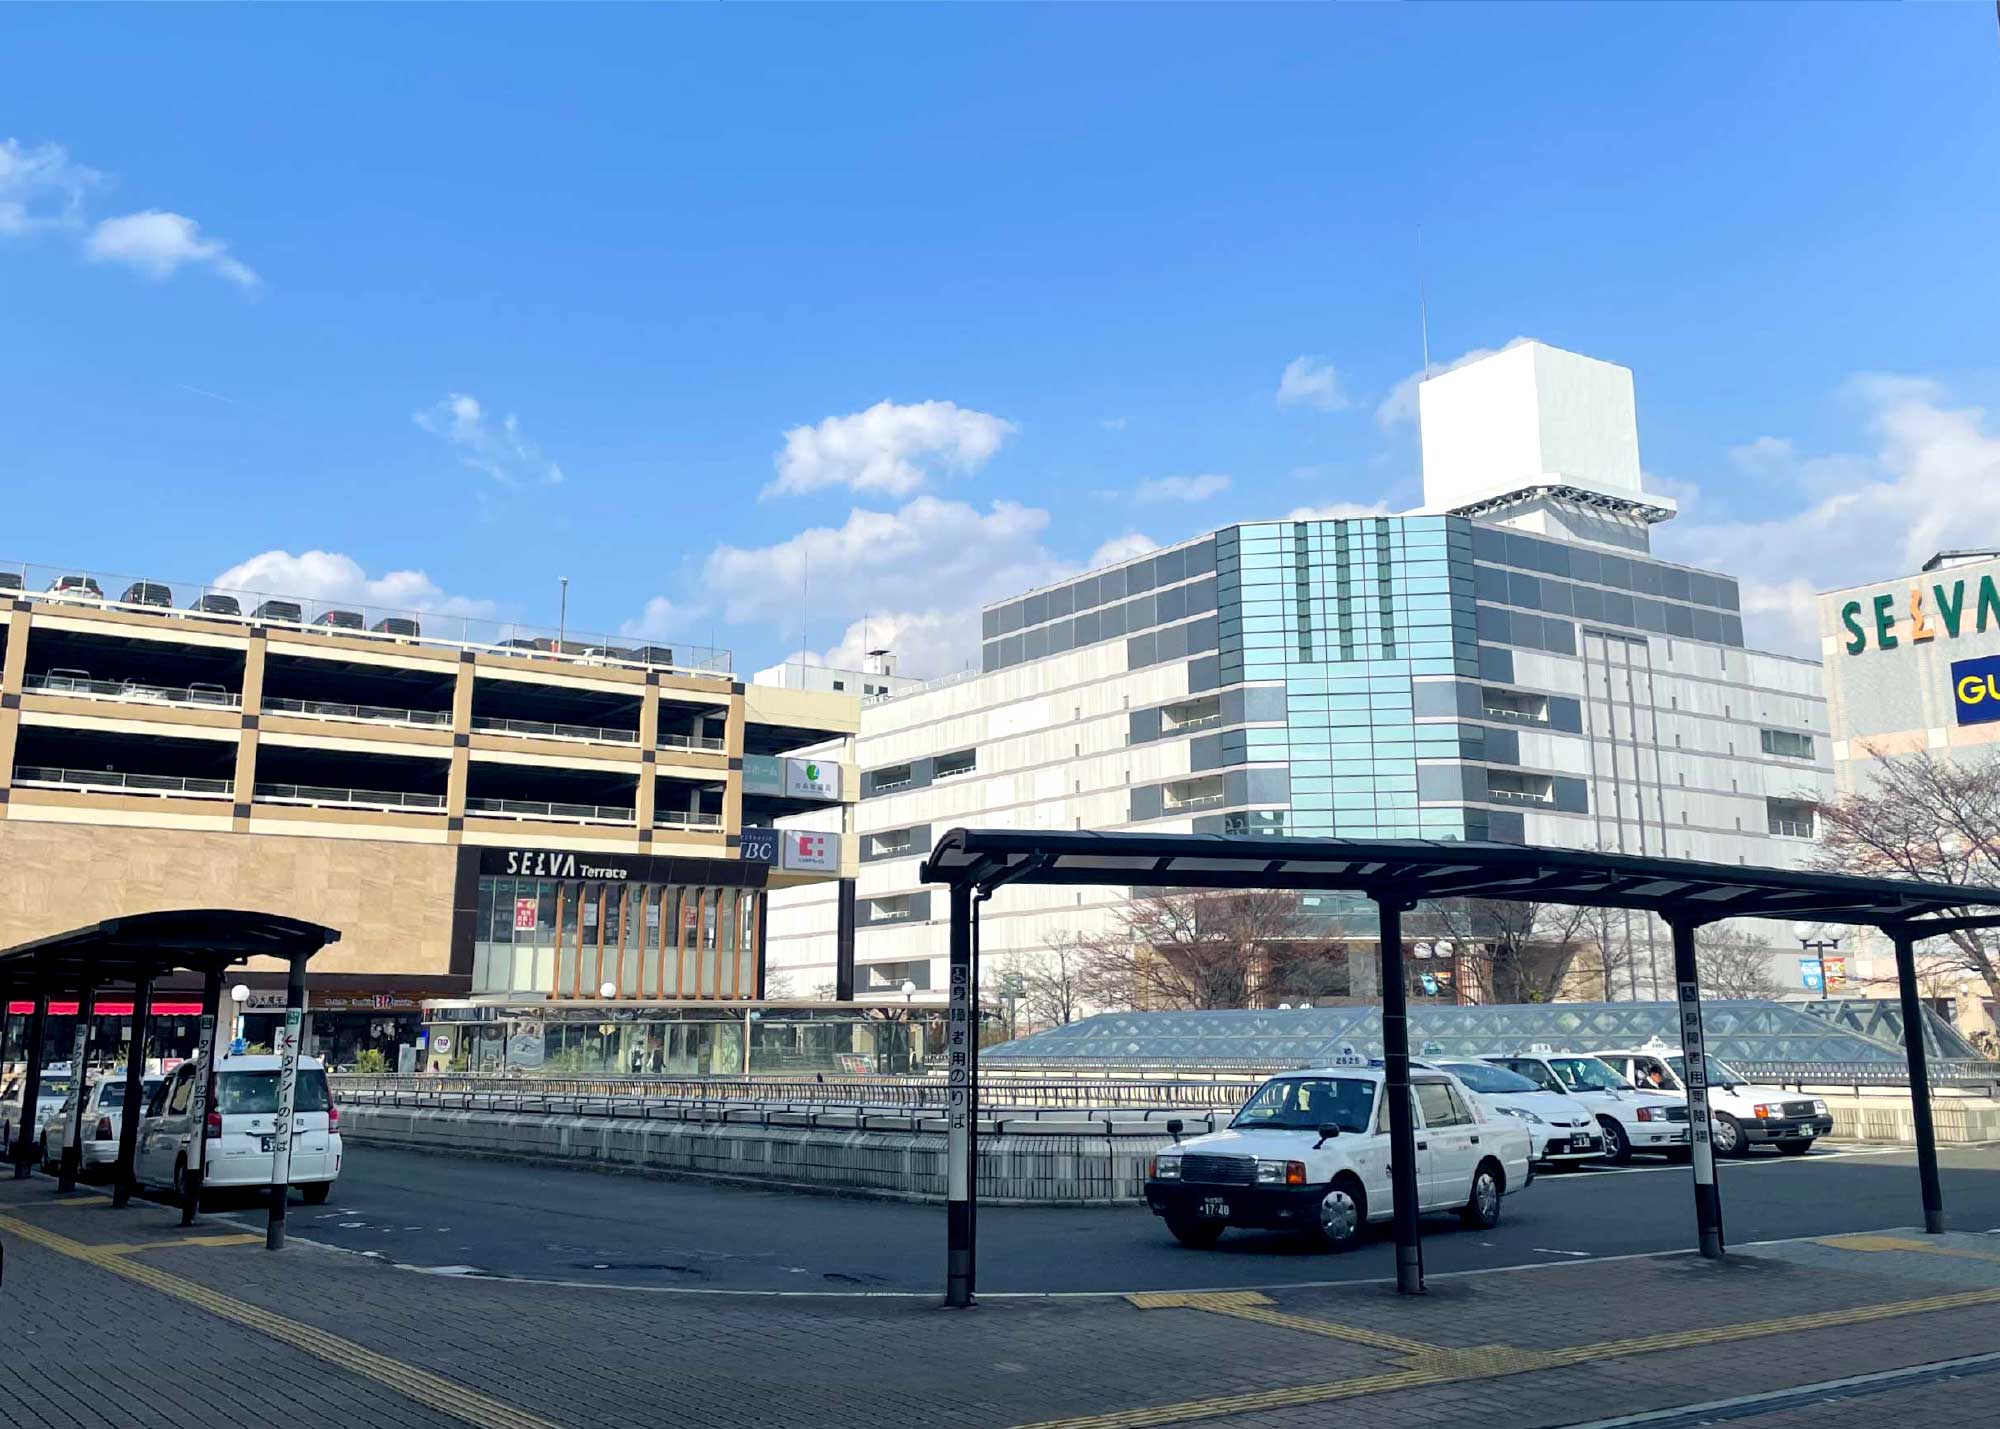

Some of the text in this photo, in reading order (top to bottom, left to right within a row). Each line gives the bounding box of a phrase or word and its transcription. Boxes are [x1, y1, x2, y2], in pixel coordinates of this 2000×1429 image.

[1842, 575, 2000, 656] SELVA
[507, 851, 627, 879] SELVA Terrace
[193, 1039, 208, 1124] タクシーのりば
[951, 986, 967, 1129] 身障者用のりば
[276, 1055, 294, 1152] タクシーのりば
